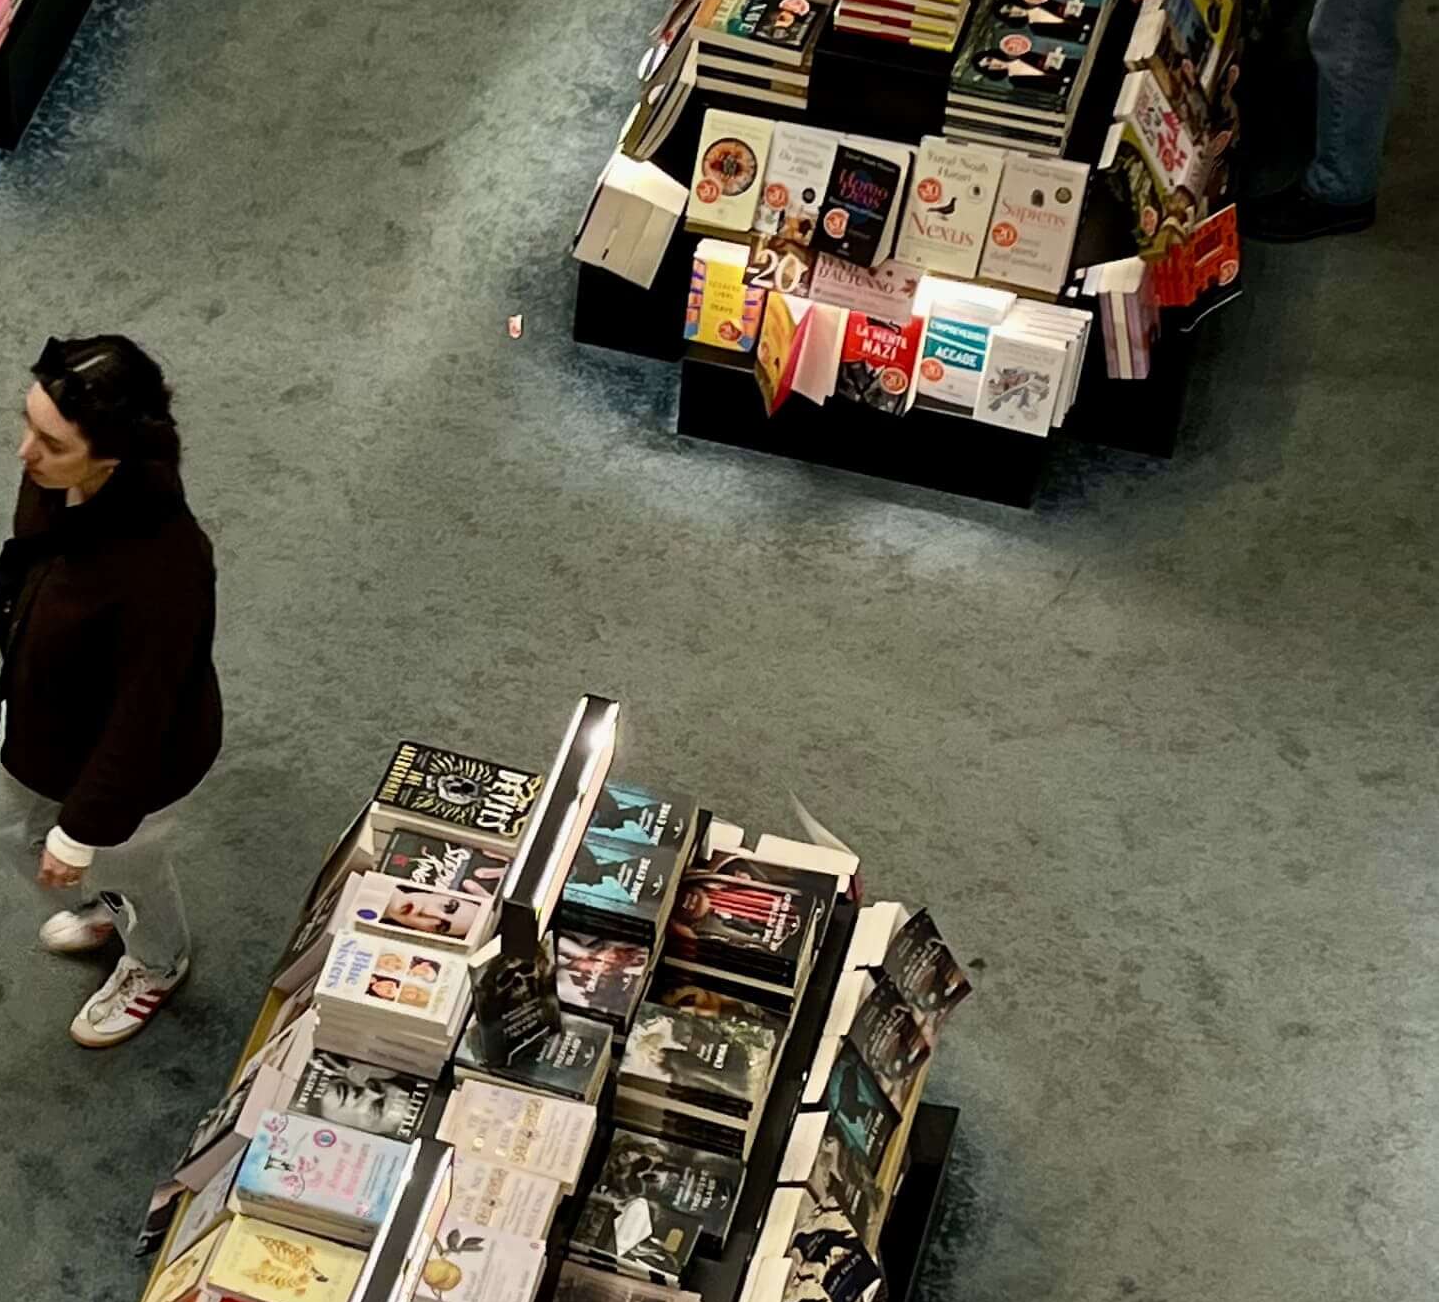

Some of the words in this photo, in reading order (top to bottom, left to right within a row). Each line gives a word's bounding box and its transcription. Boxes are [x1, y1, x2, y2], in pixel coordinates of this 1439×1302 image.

[909, 213, 975, 247] Nexus
[1000, 201, 1066, 229] Sapiens
[476, 767, 526, 833] DEVILS
[324, 935, 358, 991] Sisters
[345, 950, 372, 987] Blue
[397, 1090, 425, 1137] LITTLE
